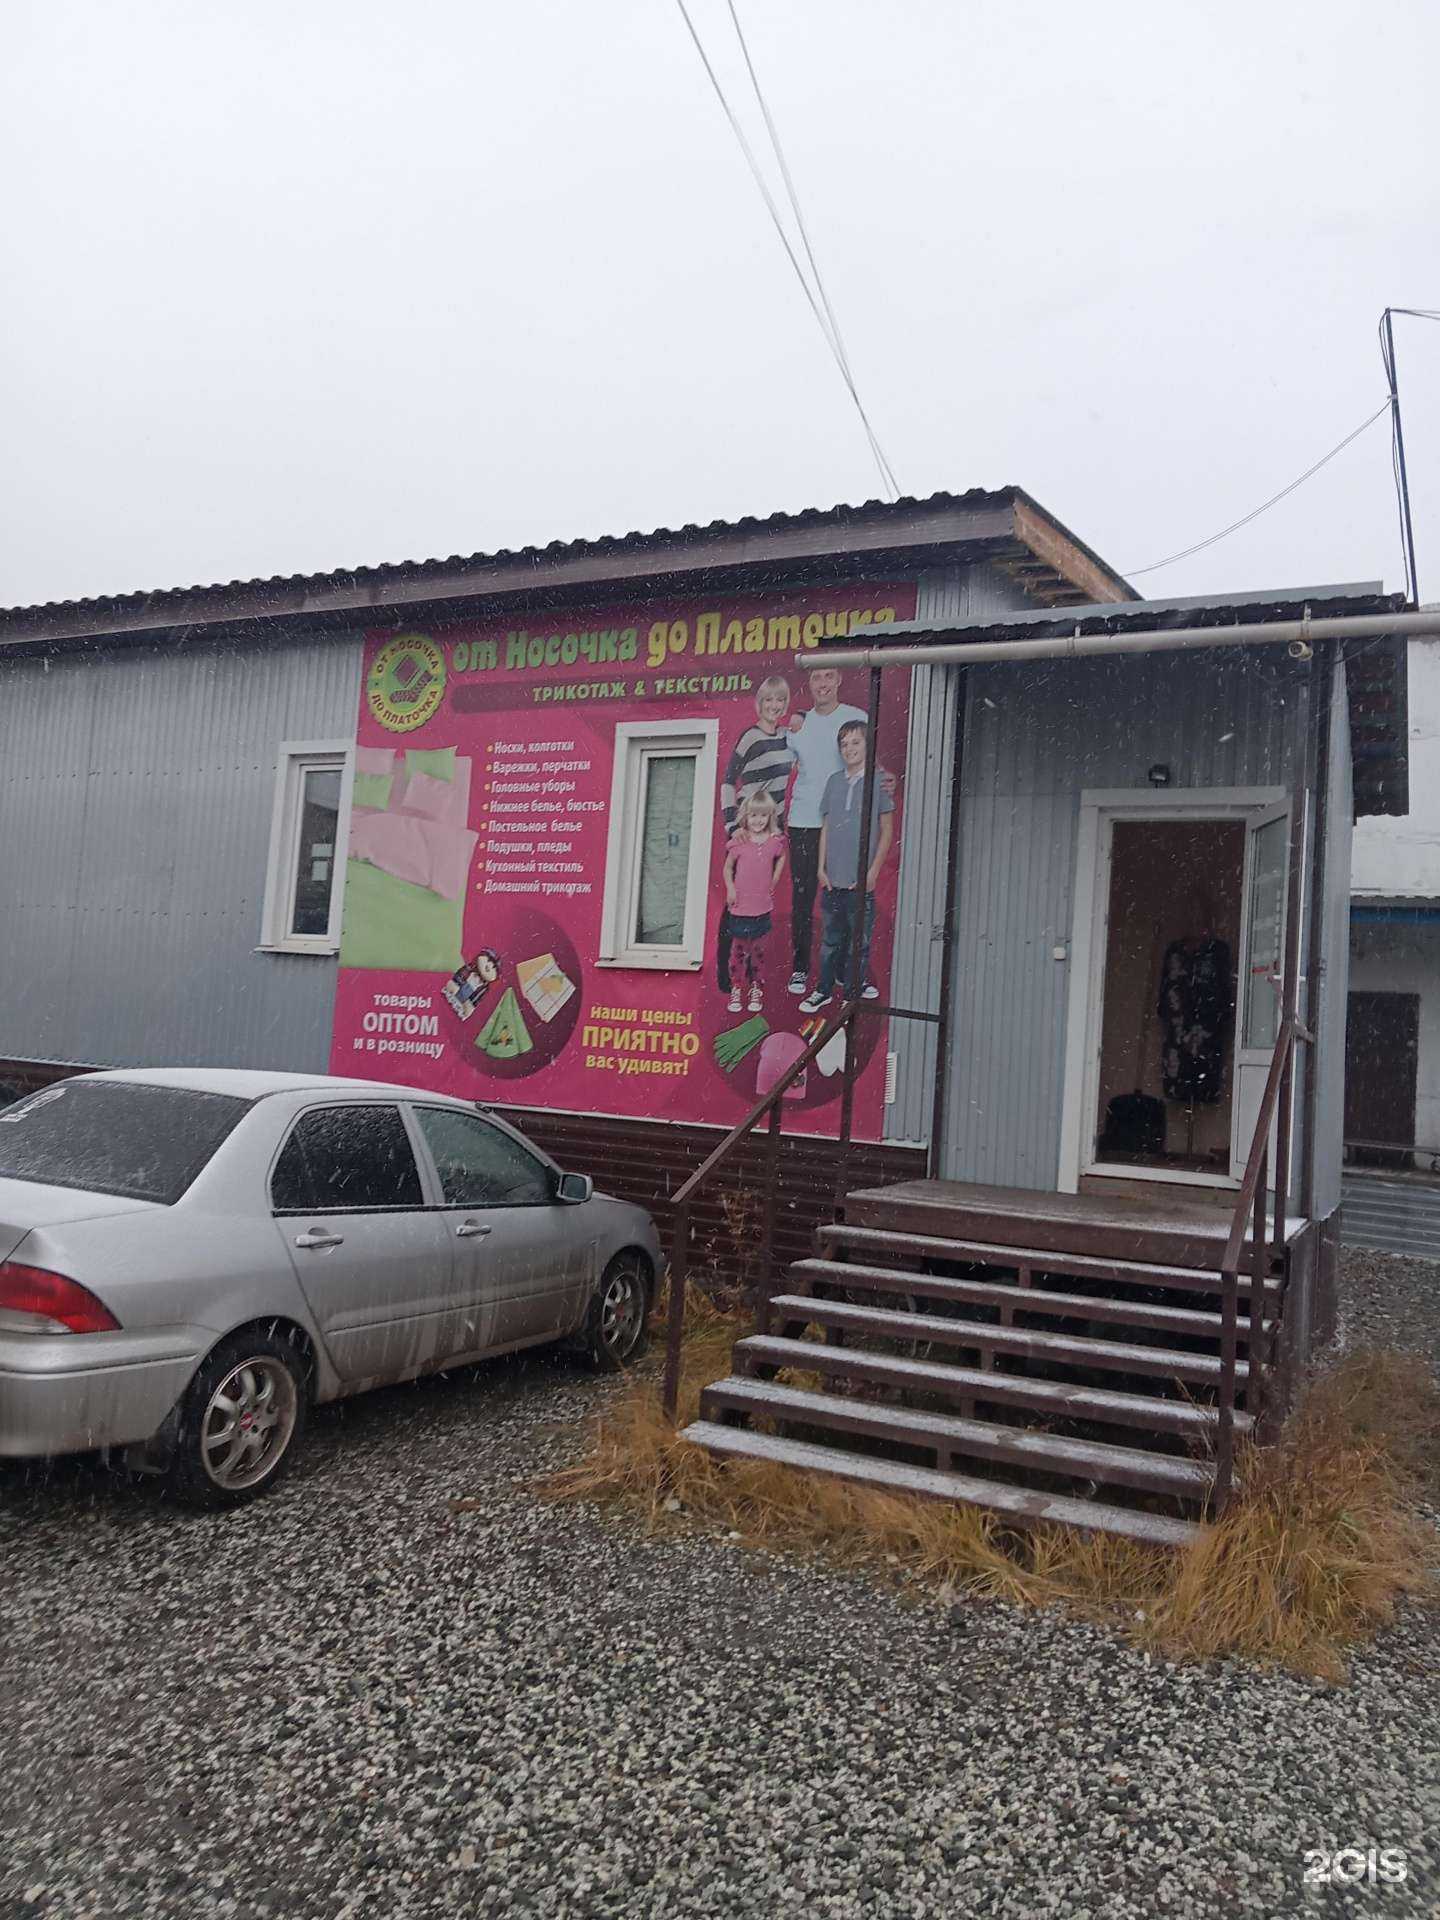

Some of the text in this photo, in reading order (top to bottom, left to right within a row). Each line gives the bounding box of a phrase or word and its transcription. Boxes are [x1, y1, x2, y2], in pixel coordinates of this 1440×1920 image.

[453, 640, 497, 672] от
[506, 628, 639, 670] Носочка
[646, 620, 688, 668] до
[532, 675, 752, 701] ТРИКОТАЖ & ТЕКСТИЛЬ
[494, 741, 574, 754] Носки, колготки
[492, 760, 591, 776] Варежки, перчатки
[491, 779, 576, 795] Головные уборы
[490, 799, 605, 813] Нижнее белье, бюстье
[488, 819, 583, 832] Постельное белье
[487, 840, 572, 855] Подушки, пледы
[485, 859, 584, 875] Кухонный текстиль
[484, 879, 592, 895] Домашний трикотаж
[373, 994, 432, 1011] товары
[363, 1012, 439, 1036] ОПТОМ
[590, 1006, 692, 1026] наши цены
[353, 1038, 445, 1059] и в розницу
[582, 1025, 700, 1056] ПРИЯТНО
[585, 1054, 689, 1076] вас удивят!
